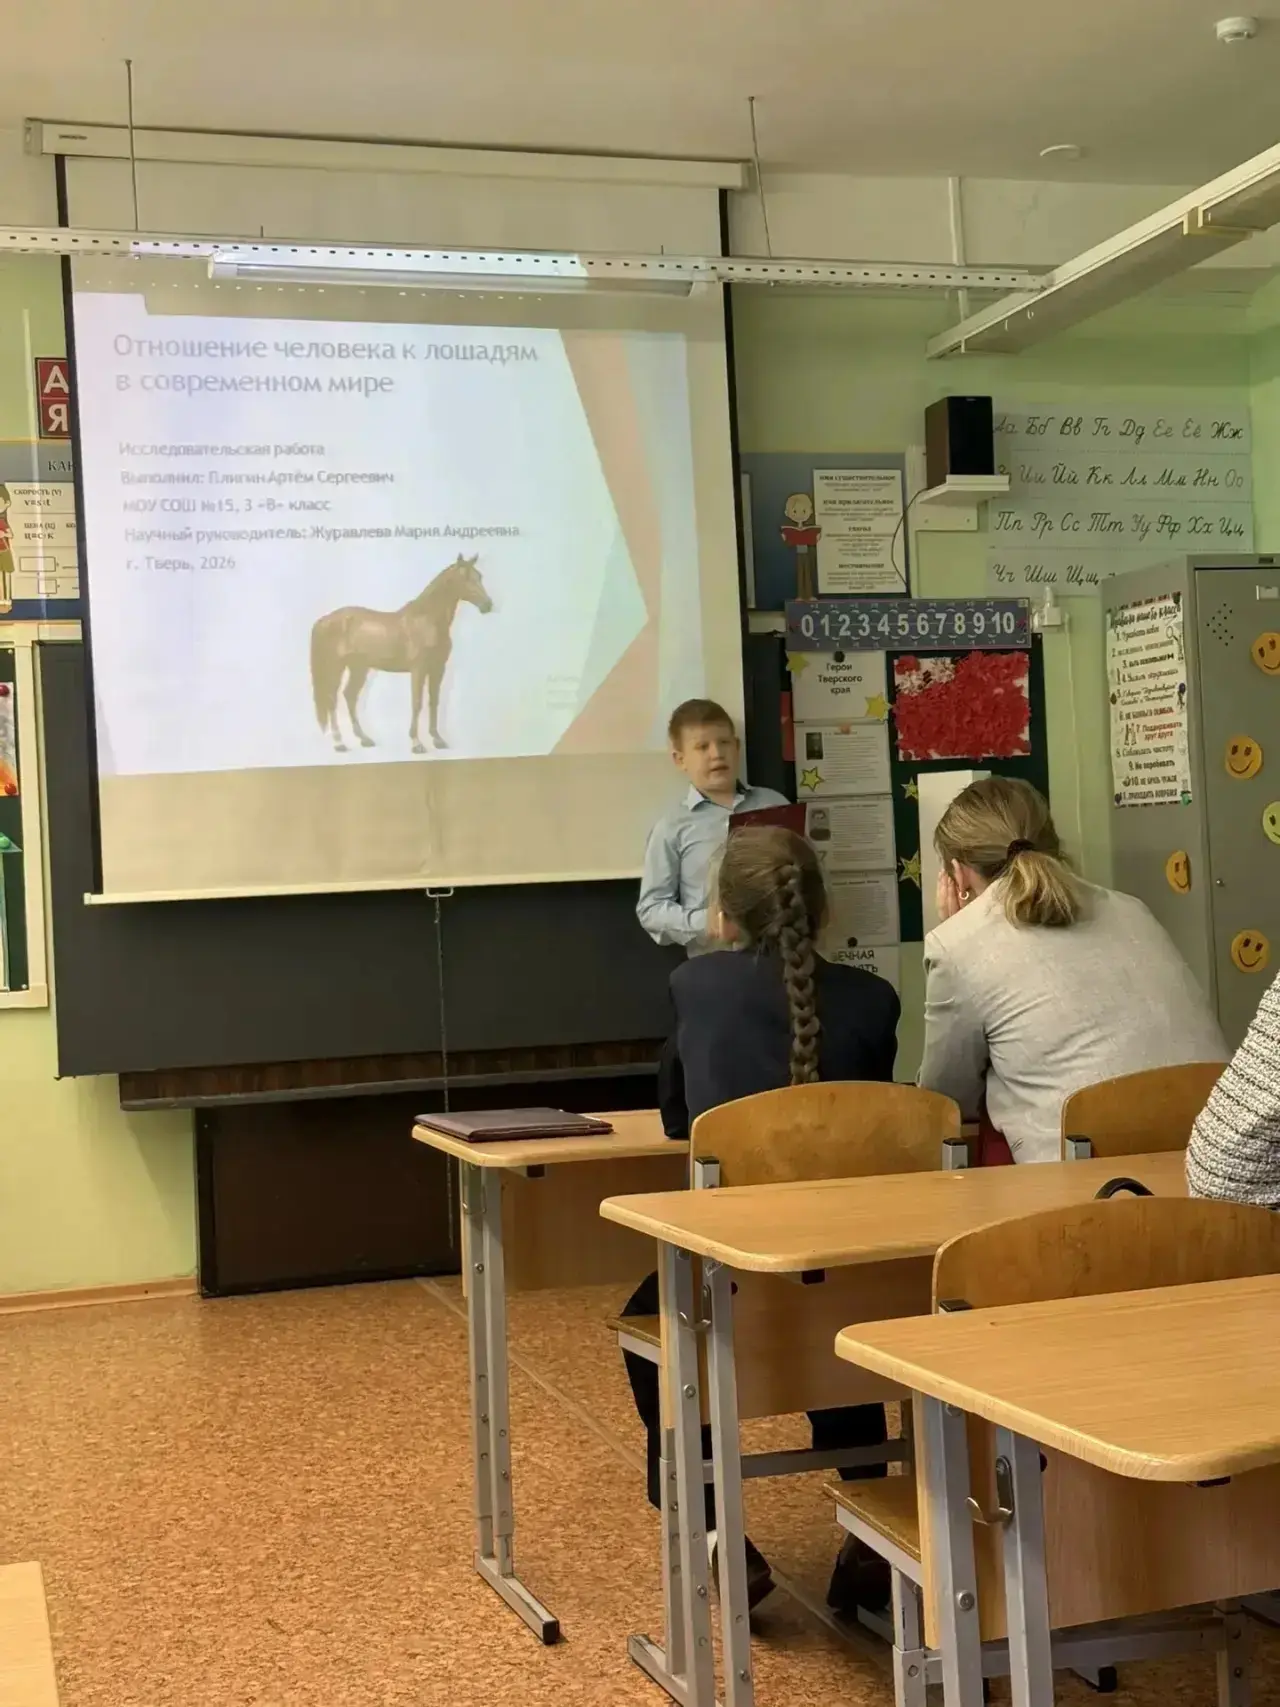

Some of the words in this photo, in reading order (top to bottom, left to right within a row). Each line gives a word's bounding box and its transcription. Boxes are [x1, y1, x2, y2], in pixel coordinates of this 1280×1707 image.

[113, 334, 268, 358] Отношение
[274, 340, 396, 360] человека
[402, 343, 416, 360] к
[424, 342, 537, 366] лошадям
[44, 365, 69, 393] А
[116, 374, 130, 391] в
[140, 374, 322, 396] современном
[328, 375, 394, 397] мире
[48, 403, 69, 432] Я
[1025, 417, 1054, 435] Бб
[1060, 416, 1083, 436] Вв
[1092, 417, 1111, 436] Гг
[1119, 419, 1145, 445] Дд
[1153, 419, 1173, 437] Ее
[1211, 421, 1244, 439] Жж
[119, 441, 271, 457] Исследовательская
[274, 442, 325, 458] работа
[121, 470, 205, 485] Выполнил:
[267, 469, 314, 485] Артём
[317, 470, 394, 486] Сергеевич
[1020, 465, 1046, 484] Ии
[1053, 462, 1080, 485] Йй
[1086, 465, 1113, 485] Кк
[1120, 467, 1147, 486] Лл
[1153, 467, 1186, 486] Мм
[1192, 468, 1219, 487] Нн
[1224, 469, 1244, 488] Оо
[160, 498, 196, 512] СОШ
[244, 498, 254, 512] 3
[288, 500, 331, 511] класс
[125, 526, 193, 542] Научный
[196, 527, 306, 544] руководитель:
[310, 525, 392, 543] Журавлева
[394, 524, 440, 540] Мария
[443, 524, 520, 540] Андреевна
[994, 511, 1023, 532] Пп
[1030, 511, 1054, 539] Рр
[1060, 512, 1080, 532] Сс
[1087, 512, 1124, 533] Тт
[1131, 513, 1151, 541] Уу
[1156, 515, 1181, 540] Фф
[1187, 516, 1213, 534] Хх
[1219, 516, 1244, 537] Цц
[200, 556, 236, 570] 2026
[993, 564, 1015, 582] Чч
[1024, 564, 1057, 583] Шш
[1066, 564, 1099, 586] Щщ
[801, 614, 814, 638] 0
[820, 614, 830, 637] 1
[838, 613, 851, 637] 2
[858, 613, 871, 637] 3
[877, 613, 890, 636] 4
[897, 613, 910, 636] 5
[917, 613, 930, 635] 6
[935, 613, 947, 635] 7
[954, 612, 966, 635] 8
[973, 612, 985, 635] 9
[991, 611, 1015, 634] 10
[826, 662, 853, 673] Герои
[818, 673, 863, 685] Тверского
[830, 687, 851, 696] края
